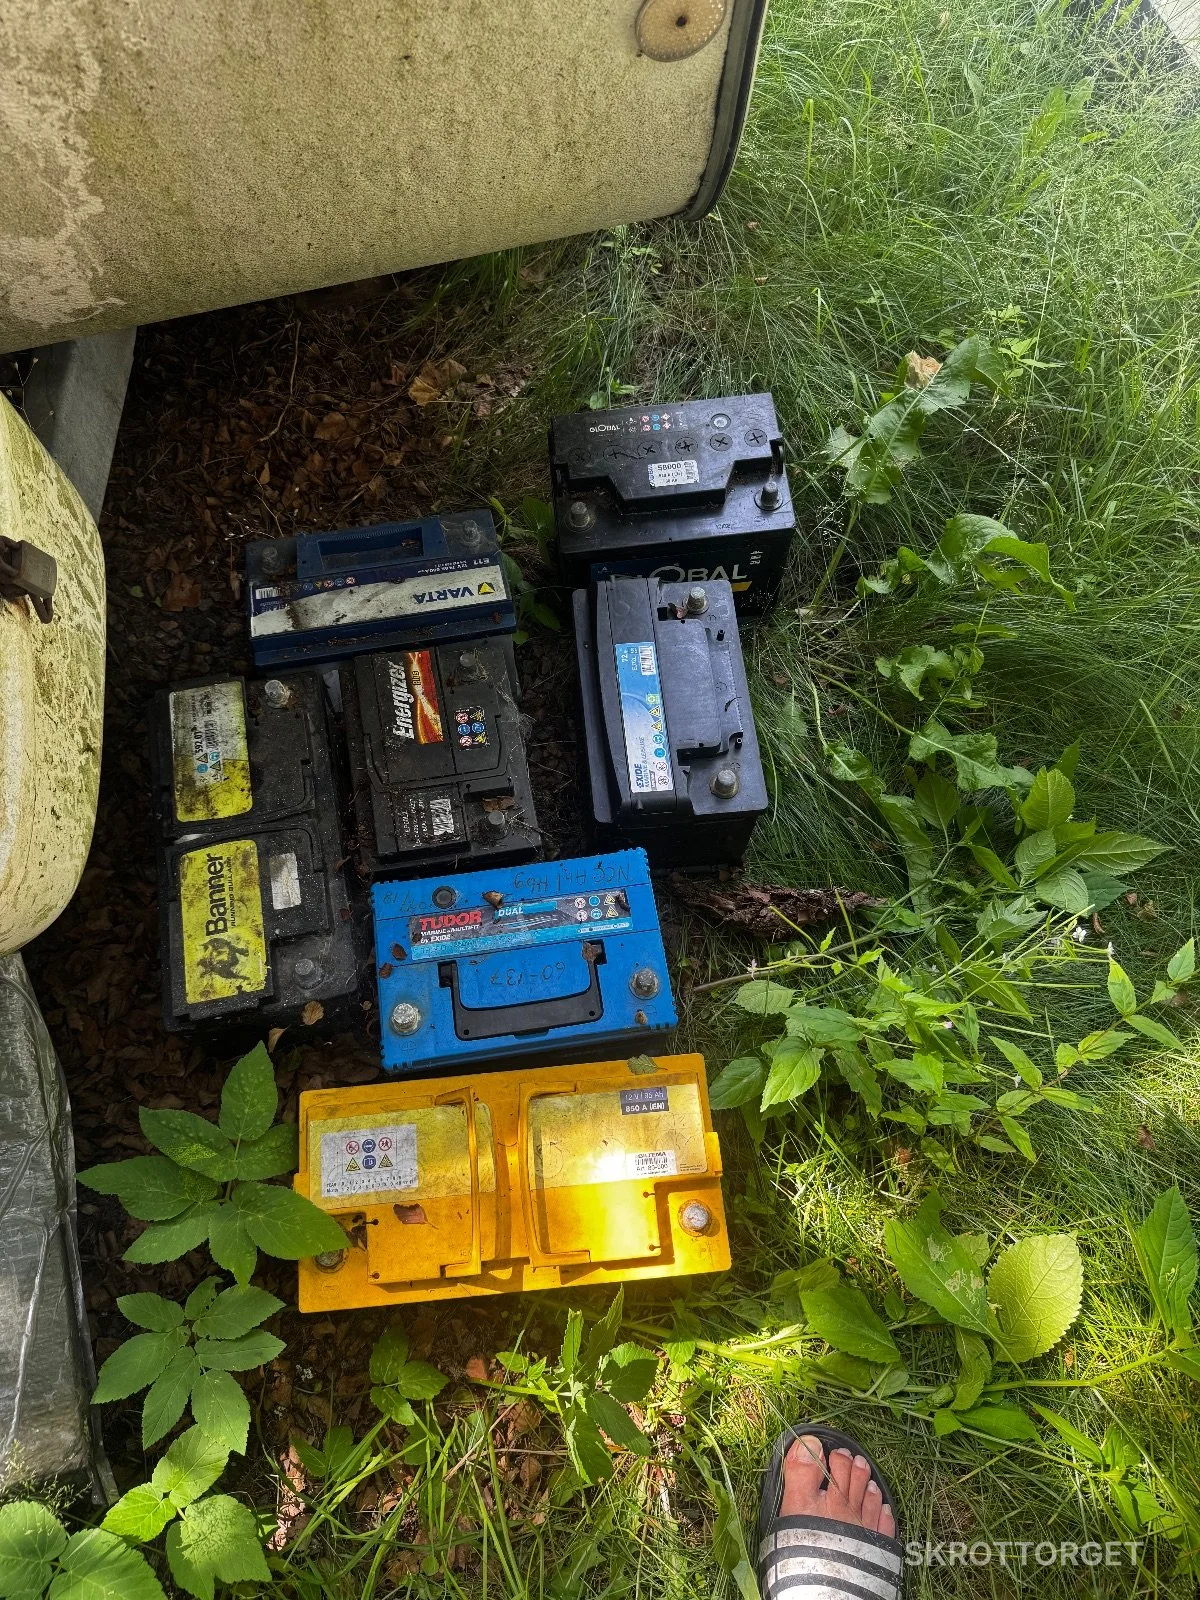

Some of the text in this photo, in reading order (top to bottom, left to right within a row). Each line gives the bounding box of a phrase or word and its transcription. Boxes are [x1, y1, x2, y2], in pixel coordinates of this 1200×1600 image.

[648, 563, 748, 583] OBAL
[412, 586, 474, 604] VARTA
[412, 670, 422, 686] Plus
[387, 660, 415, 740] Energizer
[634, 763, 645, 788] EXIDE
[204, 853, 229, 936] Banner
[419, 911, 482, 931] TUDOR
[498, 906, 524, 917] DUAL
[431, 934, 451, 942] EXIDE
[625, 1104, 640, 1112] 850
